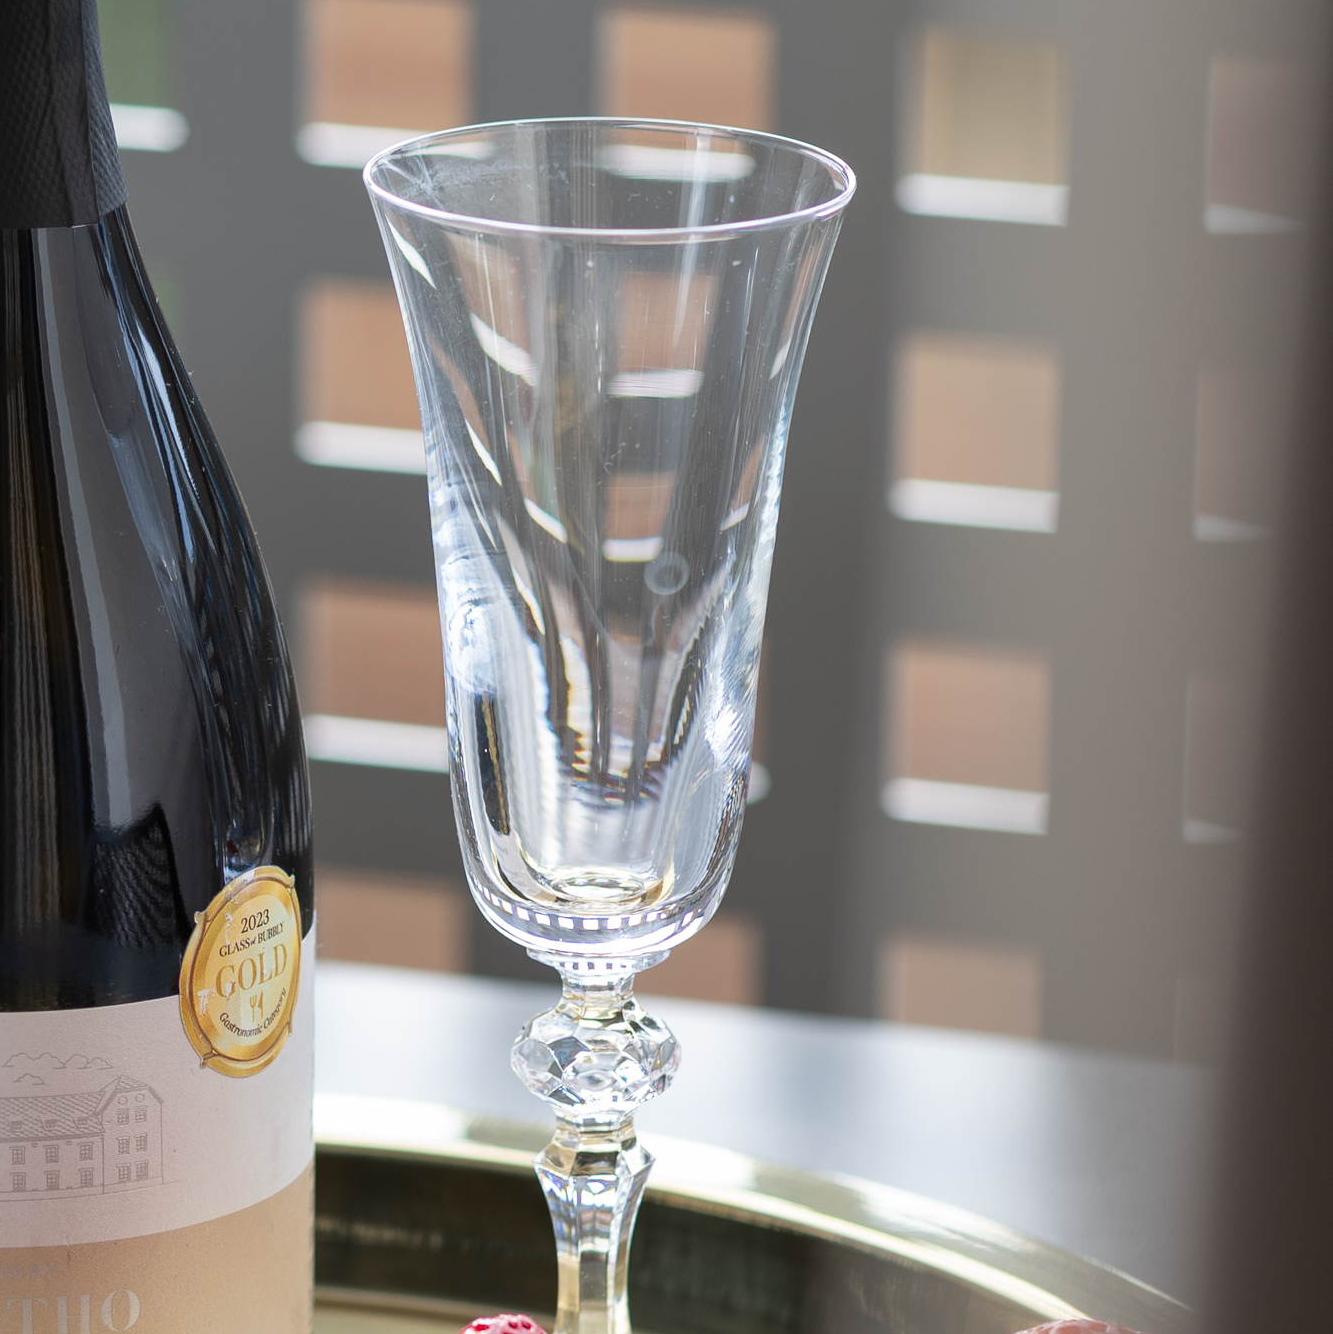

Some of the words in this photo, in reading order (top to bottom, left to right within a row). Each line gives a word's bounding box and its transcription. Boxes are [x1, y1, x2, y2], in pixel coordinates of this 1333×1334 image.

[219, 939, 251, 958] GLASS
[257, 921, 285, 945] BUBBLY
[240, 909, 270, 934] 2023
[216, 943, 288, 998] GOLD
